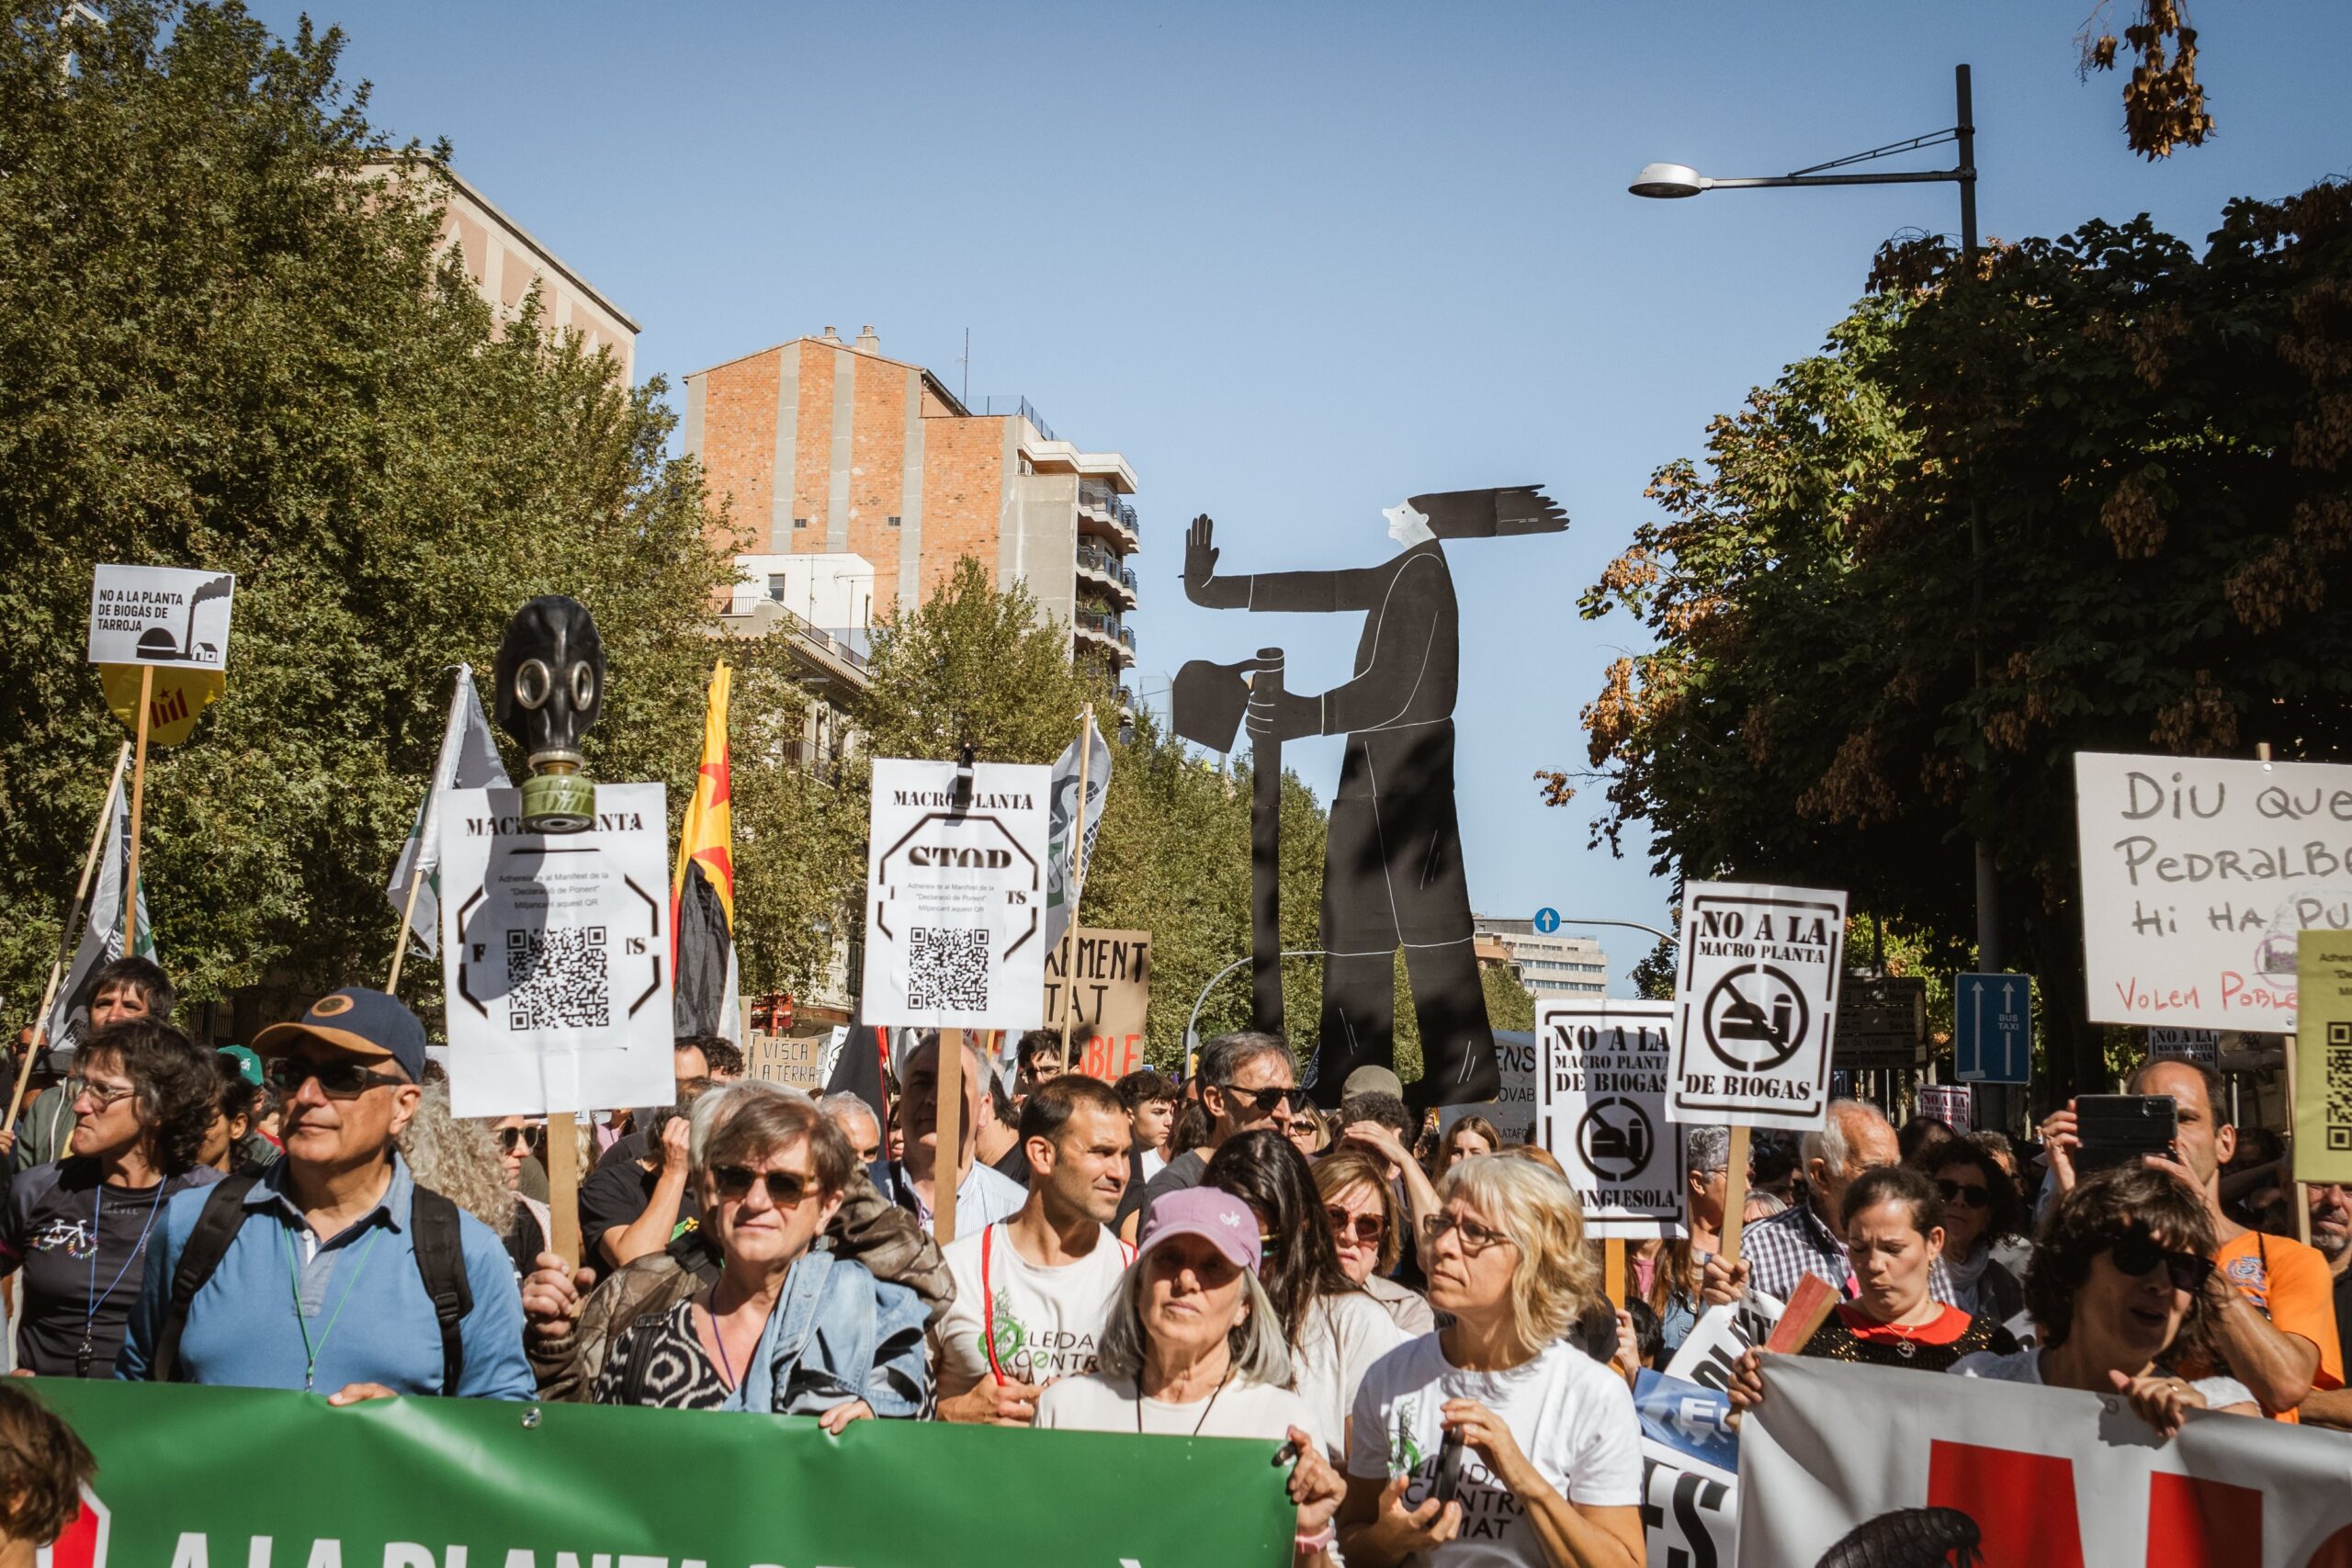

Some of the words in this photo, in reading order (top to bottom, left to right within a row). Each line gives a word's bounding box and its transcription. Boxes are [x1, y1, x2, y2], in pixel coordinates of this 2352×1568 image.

[100, 590, 114, 601] NO
[117, 591, 123, 602] A
[127, 591, 139, 603] LA
[142, 592, 183, 605] PLANTA
[98, 604, 111, 615] DE
[114, 604, 152, 617] BIOGÀS
[154, 607, 168, 618] DE
[97, 619, 142, 632] TARROJA
[971, 793, 1034, 810] LANTA
[1700, 910, 1744, 939] NO
[1753, 914, 1774, 941] A
[1787, 916, 1827, 946] LA
[1699, 942, 1756, 958] MACRO
[1760, 945, 1826, 964] PLANTA
[1997, 1022, 2019, 1031] TAXI
[1554, 1025, 1598, 1051] NO
[1608, 1026, 1627, 1051] A
[1637, 1026, 1670, 1052] LA
[2157, 1030, 2177, 1043] NO
[2180, 1030, 2191, 1043] A
[2197, 1030, 2212, 1043] LA
[1555, 1055, 1611, 1069] MACRO
[775, 1065, 815, 1082] TERRA
[1555, 1073, 1585, 1091] DE
[1594, 1073, 1667, 1093] BIOGAS
[1685, 1074, 1715, 1095] DE
[1723, 1075, 1810, 1100] BIOGAS
[1924, 1094, 1939, 1104] NO
[1952, 1097, 1965, 1108] LA
